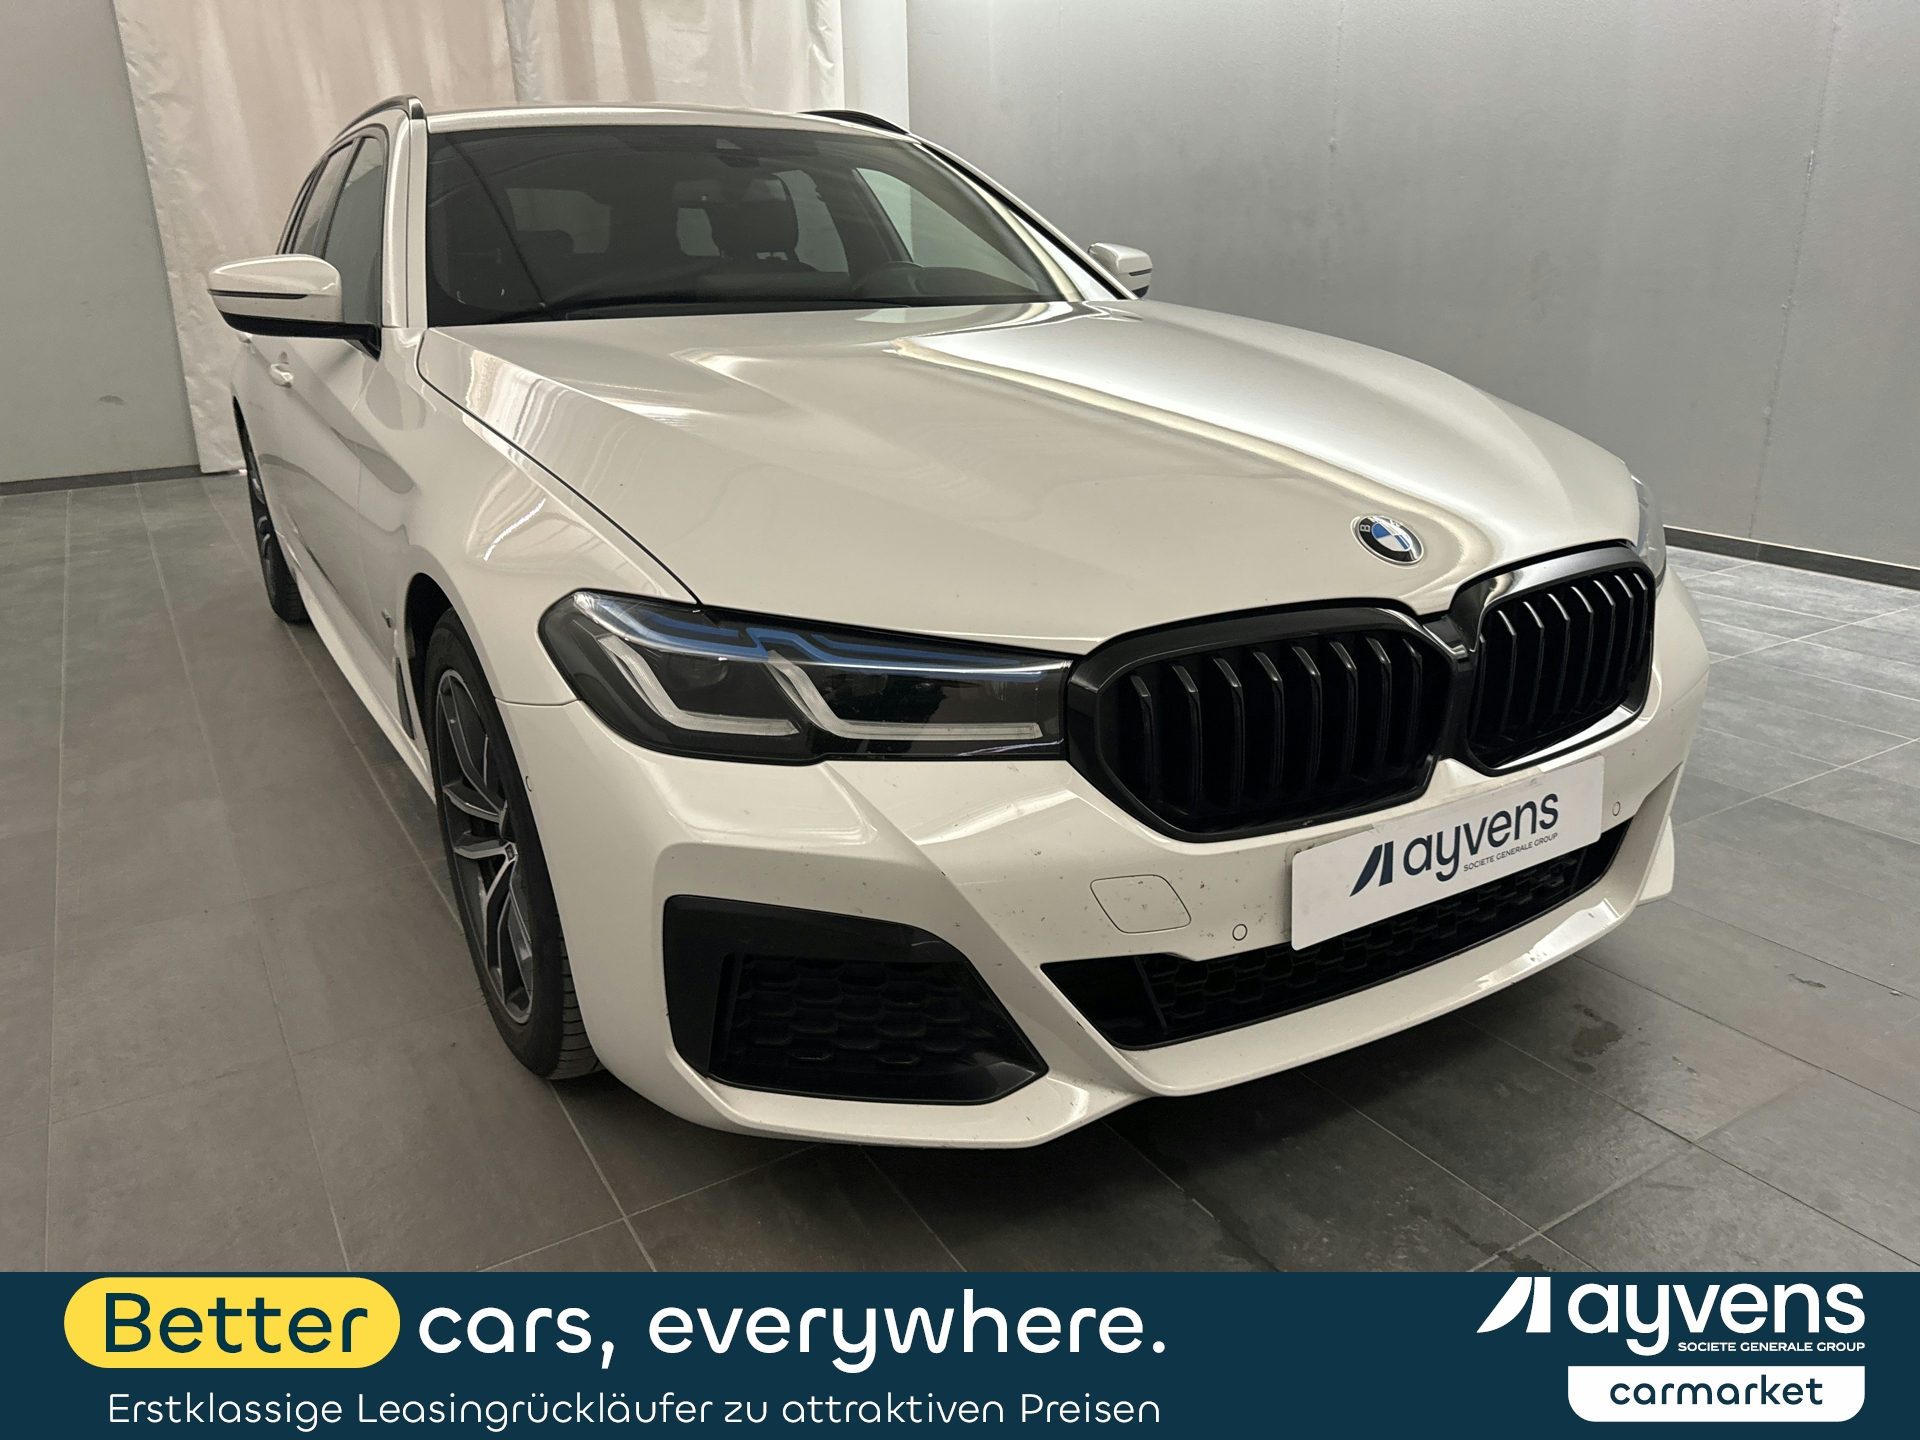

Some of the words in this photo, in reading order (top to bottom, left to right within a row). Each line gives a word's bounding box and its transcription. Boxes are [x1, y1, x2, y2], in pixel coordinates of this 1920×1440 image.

[1403, 793, 1559, 882] ayvens
[1463, 855, 1495, 872] SOCIETE
[1496, 841, 1533, 861] GENERALE
[1533, 832, 1558, 847] GROUP
